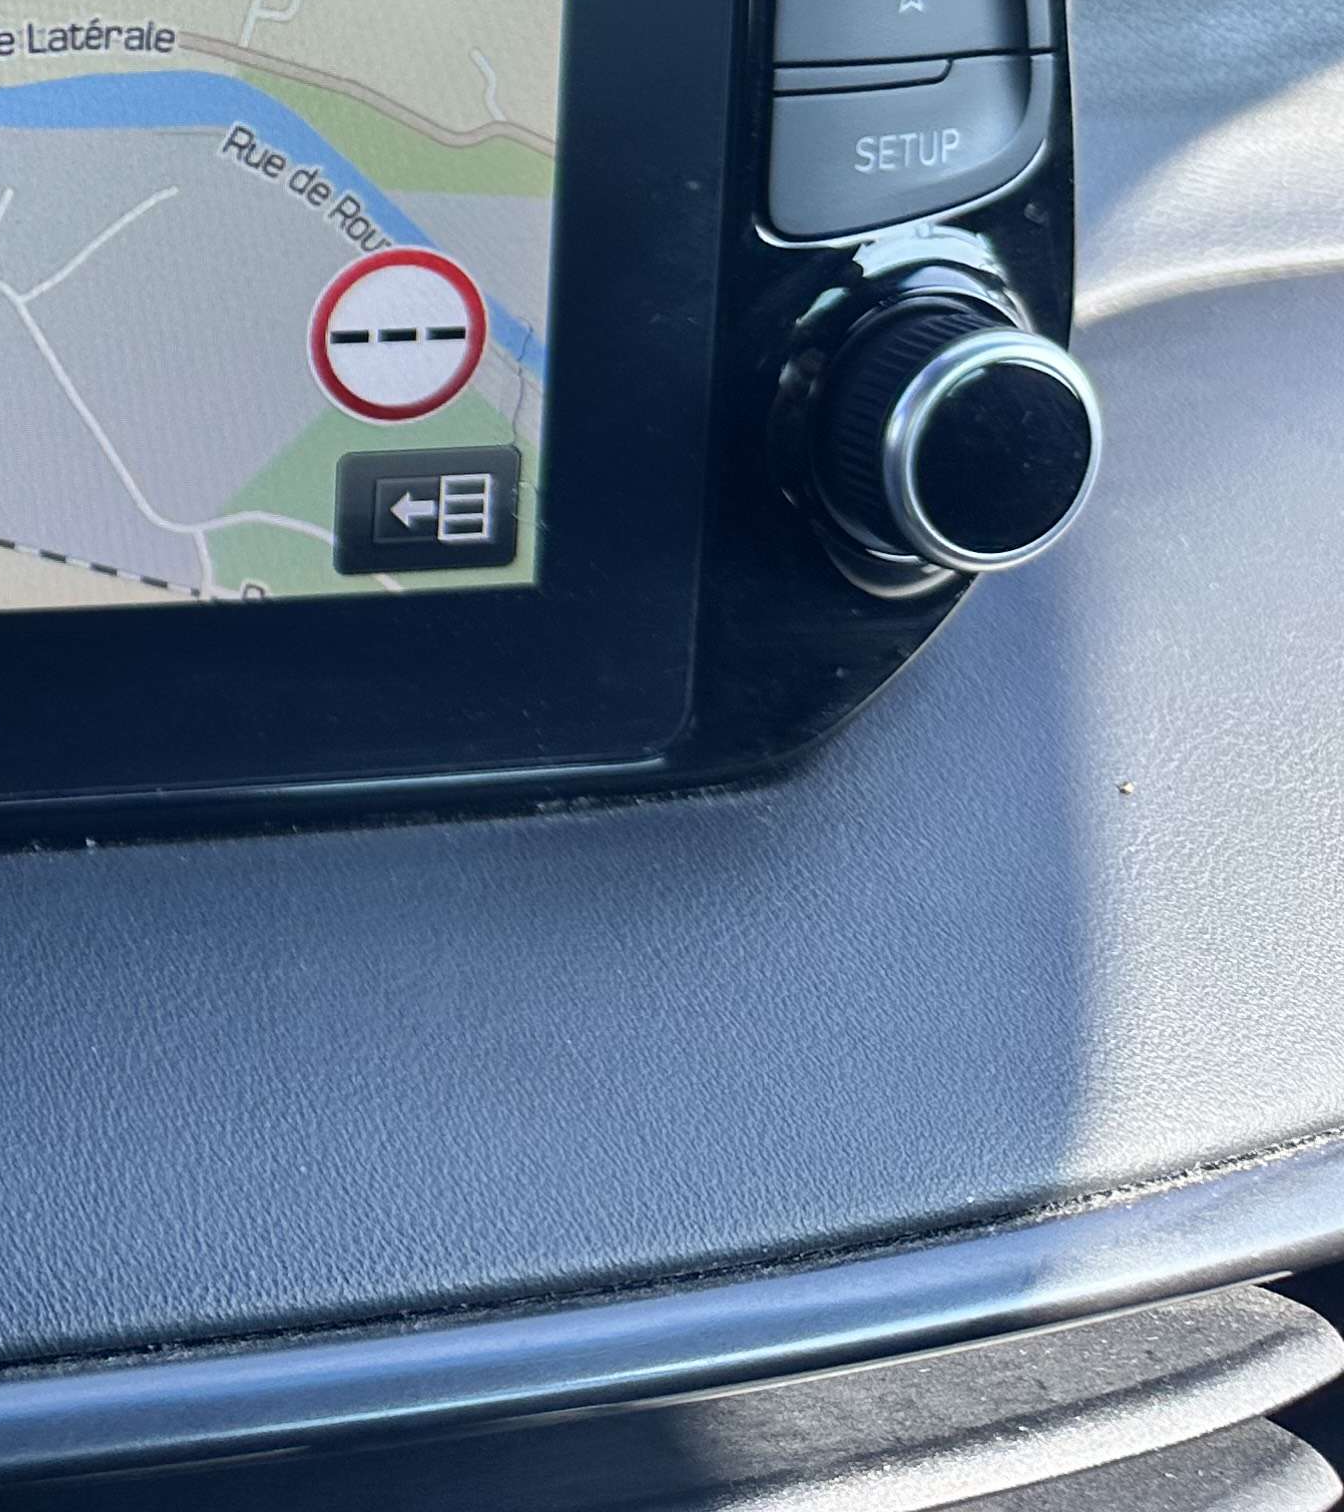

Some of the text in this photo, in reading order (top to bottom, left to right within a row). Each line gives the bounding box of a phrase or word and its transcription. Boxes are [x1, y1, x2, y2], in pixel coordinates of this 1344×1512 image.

[26, 17, 176, 54] Latérale
[222, 125, 287, 179] Rue
[288, 169, 331, 206] de
[853, 128, 962, 173] SETUP
